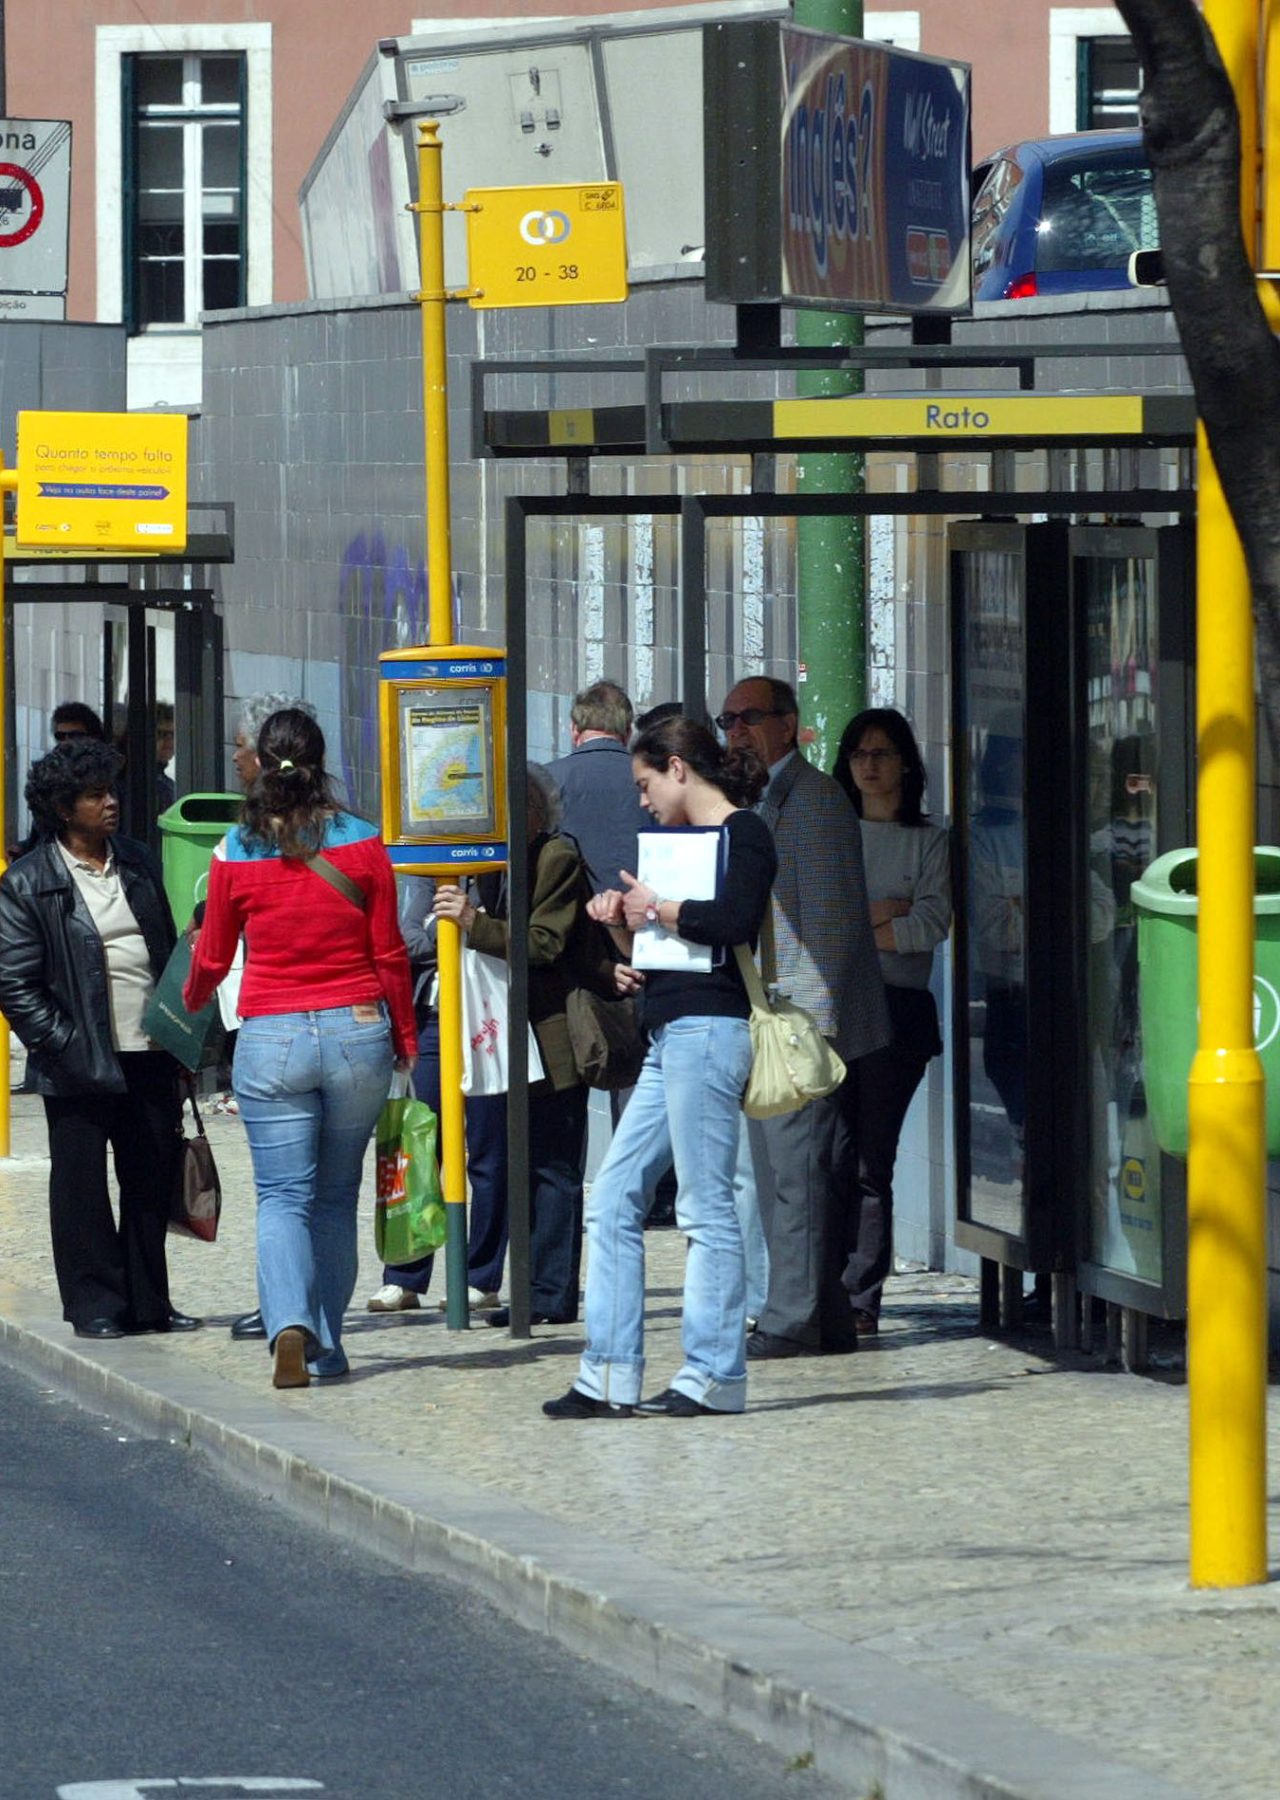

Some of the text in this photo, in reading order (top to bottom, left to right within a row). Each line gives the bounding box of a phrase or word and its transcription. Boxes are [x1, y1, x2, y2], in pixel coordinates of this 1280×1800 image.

[515, 266, 536, 281] 20
[558, 264, 579, 280] 38
[926, 404, 989, 429] Rato
[35, 444, 173, 463] Quanto tempo falta
[449, 663, 477, 674] carris
[450, 847, 478, 858] carris
